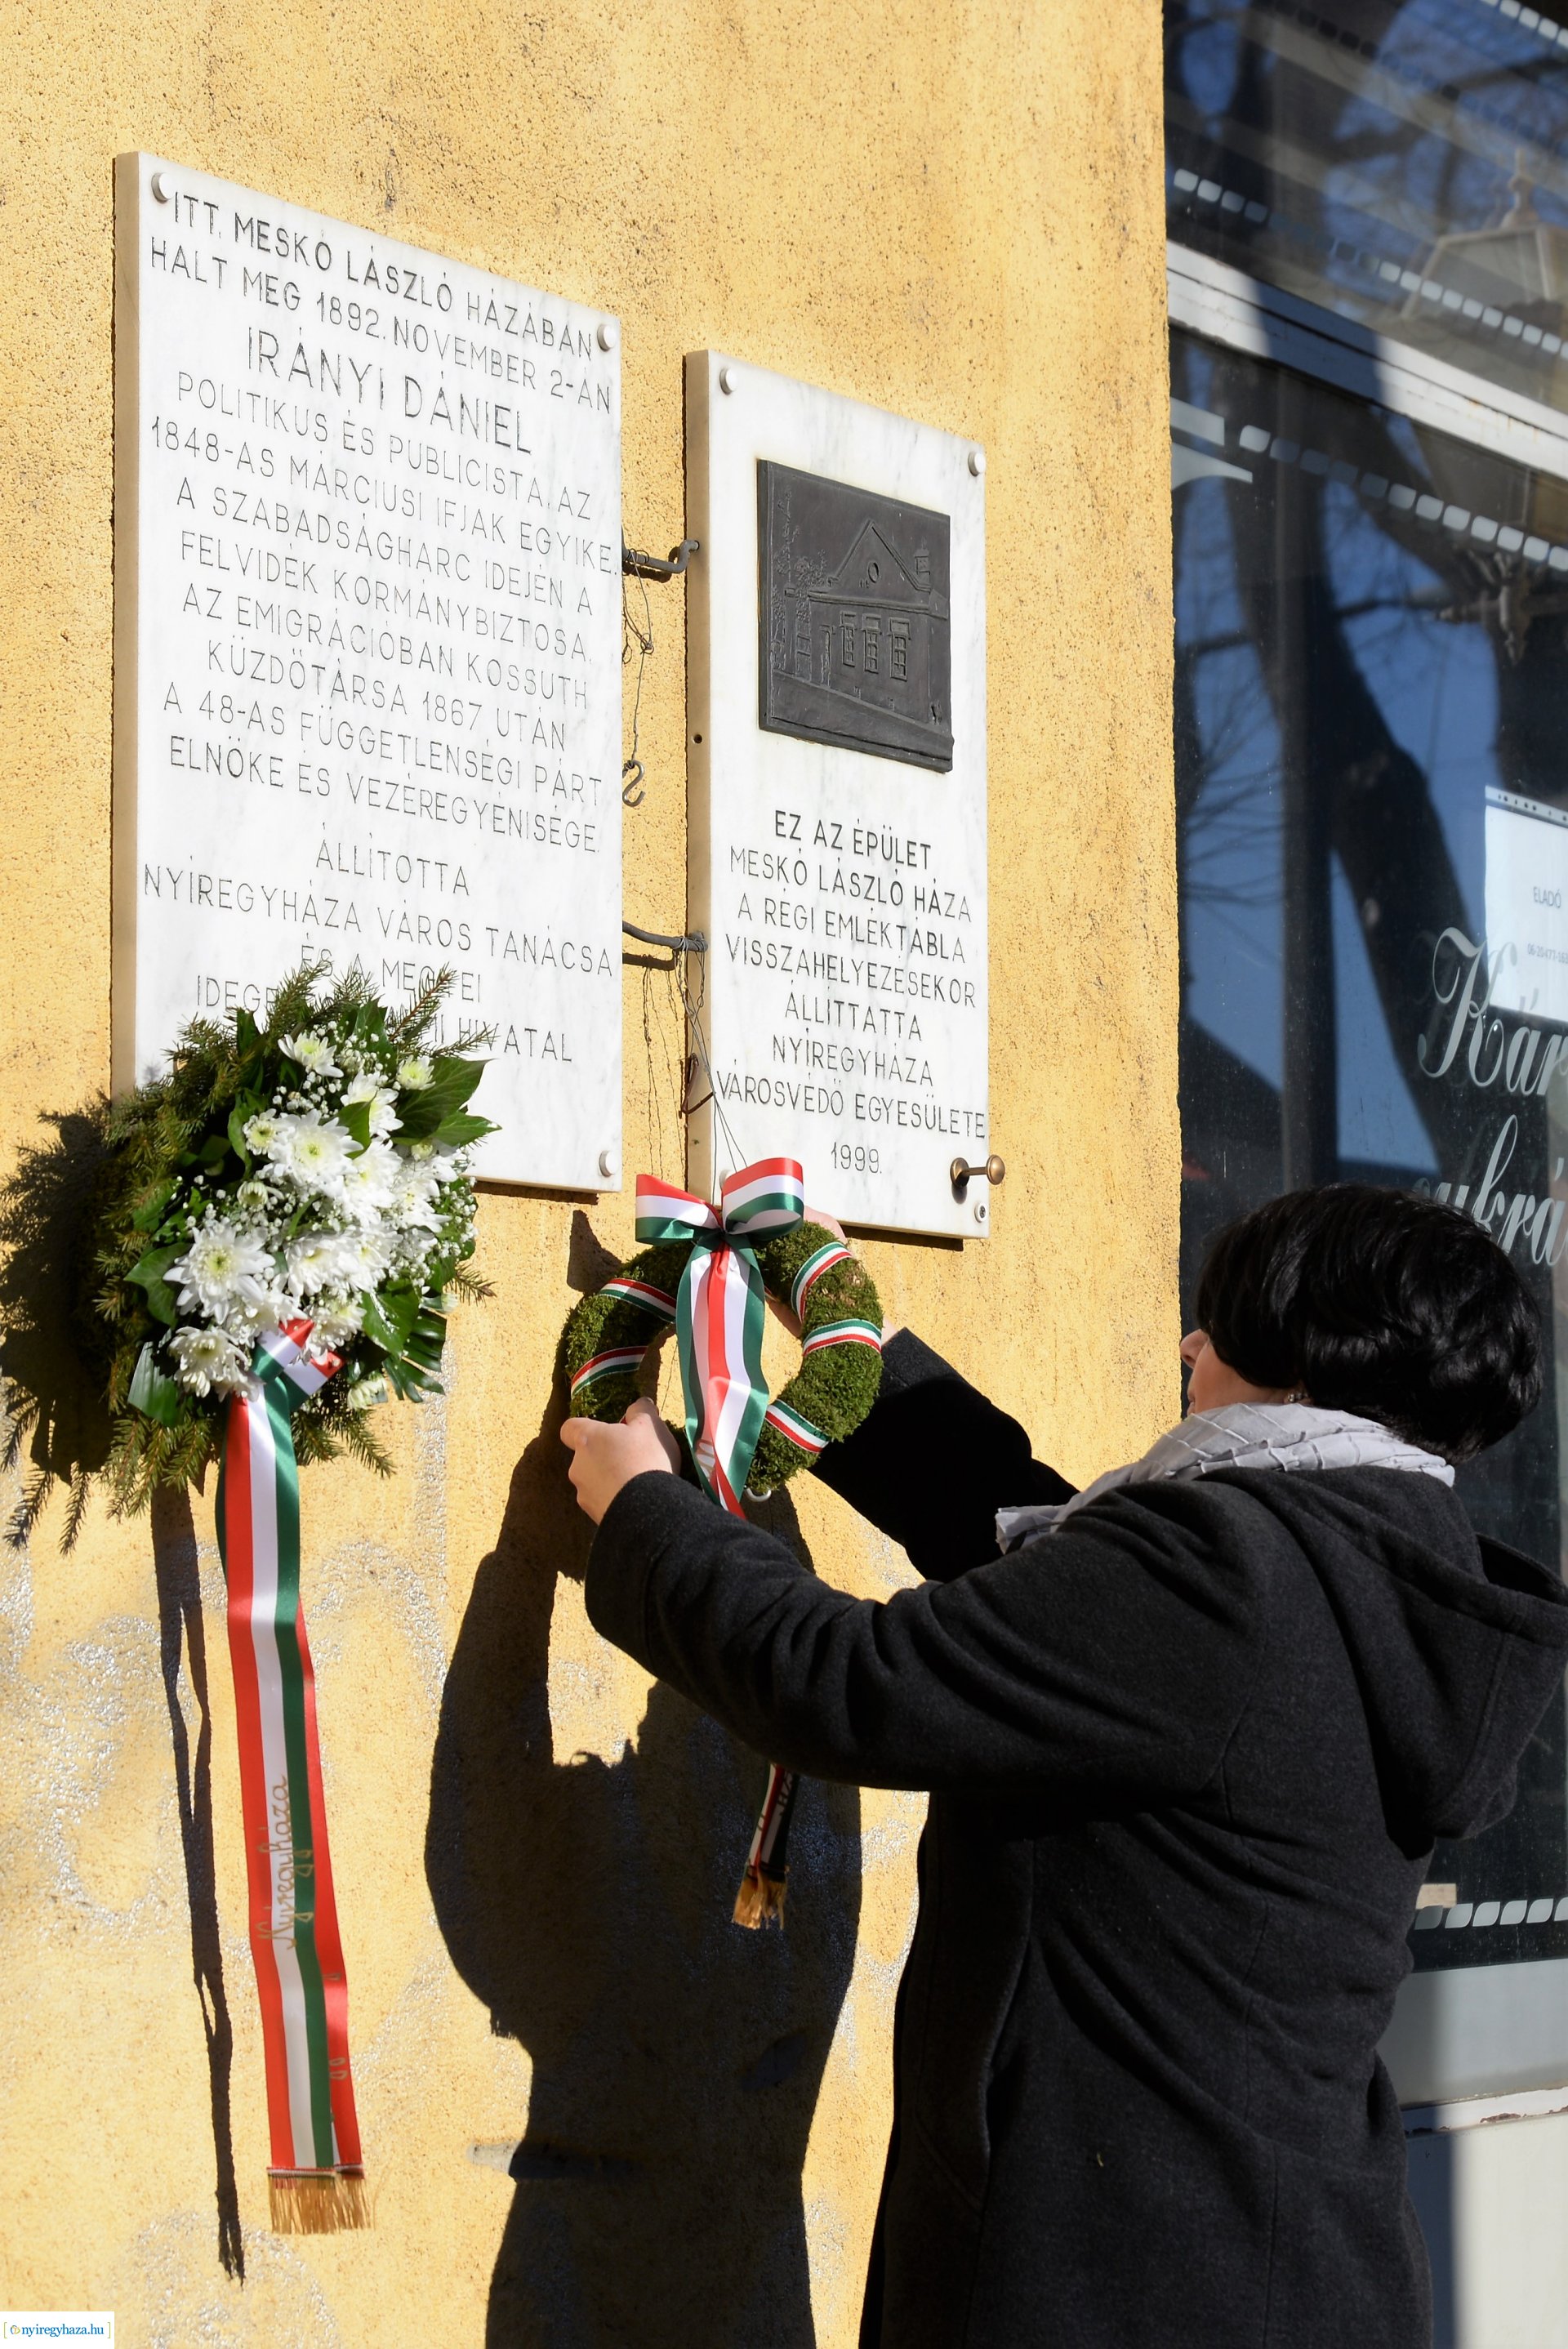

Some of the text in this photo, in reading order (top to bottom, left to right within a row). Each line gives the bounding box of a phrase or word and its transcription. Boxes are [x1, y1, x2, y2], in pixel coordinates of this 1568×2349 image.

[234, 212, 332, 271] MESKÓ
[348, 245, 452, 312] LÁSZLÓ
[468, 288, 591, 361] HÁZÁBAN
[151, 237, 611, 414] HALT MEG 1892. NOVEMBER 2-ÁN
[248, 327, 532, 454] IRÁNYI DÁNIEL
[178, 371, 328, 443] POLITIKUS
[343, 408, 374, 455] ÉS
[559, 490, 591, 520] AZ
[152, 416, 617, 575] 1848-AS MÁRCIUSI IFJAK EGYIKE.
[176, 477, 592, 616] A SZABADSÁGHARC IDEJÉN A
[181, 530, 318, 595] FELVIDÉK
[182, 582, 588, 711] AZ EMIGRÁCIÓBAN KOSSUTH
[163, 682, 602, 807] A 48-AS FÜGGETLENSÉGI PÁRT
[423, 690, 482, 731] 1867
[497, 706, 566, 751] UTÁN
[170, 734, 283, 788] ELNÖKE
[299, 749, 331, 796] ÉS
[315, 822, 470, 897] ÁLLÍTOTTA
[775, 809, 931, 871] EZ AZ ÉPÜLET
[144, 856, 613, 978] NYÍREGYHÁZA VÁROS TANÁCSA
[730, 845, 972, 923] MESKÓ LÁSZLÓ HÁZA
[1533, 885, 1561, 909] ELADÓ
[737, 889, 965, 964] A RÉGI EMLÉKTÁBLA
[351, 953, 367, 985] A
[382, 958, 481, 1003] MEGEI
[725, 934, 976, 1009] VISSZAHELYEZÉSEKOR
[458, 1017, 572, 1063] HIVATAL
[785, 979, 922, 1041] ÁLLÍTTATTA
[773, 1027, 933, 1087] NYÍREGYHÁZA
[855, 1093, 986, 1139] EGYESÜLETE
[831, 1141, 882, 1174] 1999.
